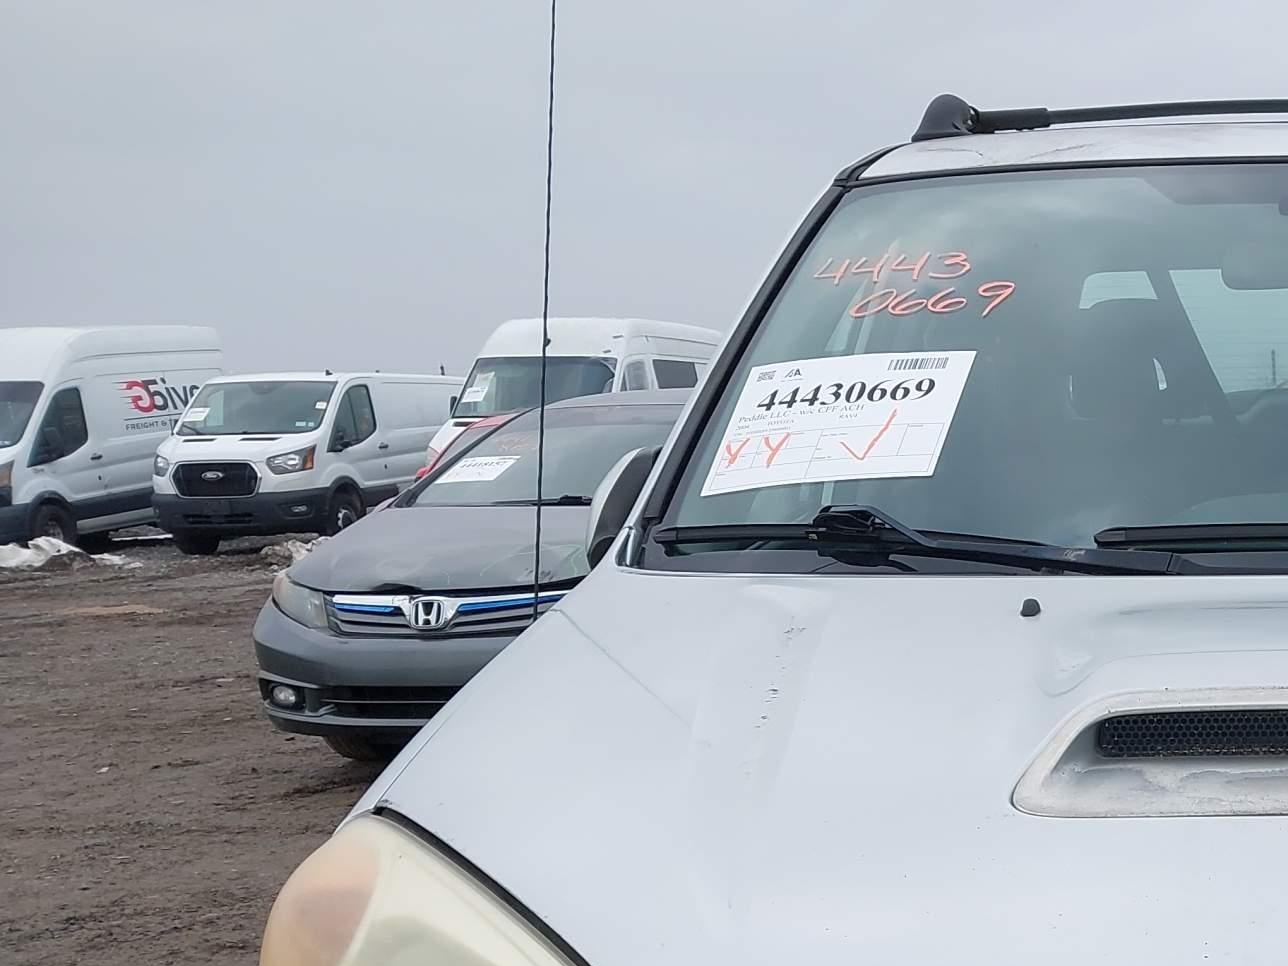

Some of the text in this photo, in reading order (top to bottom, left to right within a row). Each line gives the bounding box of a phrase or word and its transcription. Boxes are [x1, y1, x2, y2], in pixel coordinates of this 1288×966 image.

[813, 251, 972, 286] 4443
[849, 281, 1016, 318] 0669
[756, 377, 936, 412] 44430669
[125, 421, 159, 431] FREIGHT
[770, 410, 791, 419] LLC
